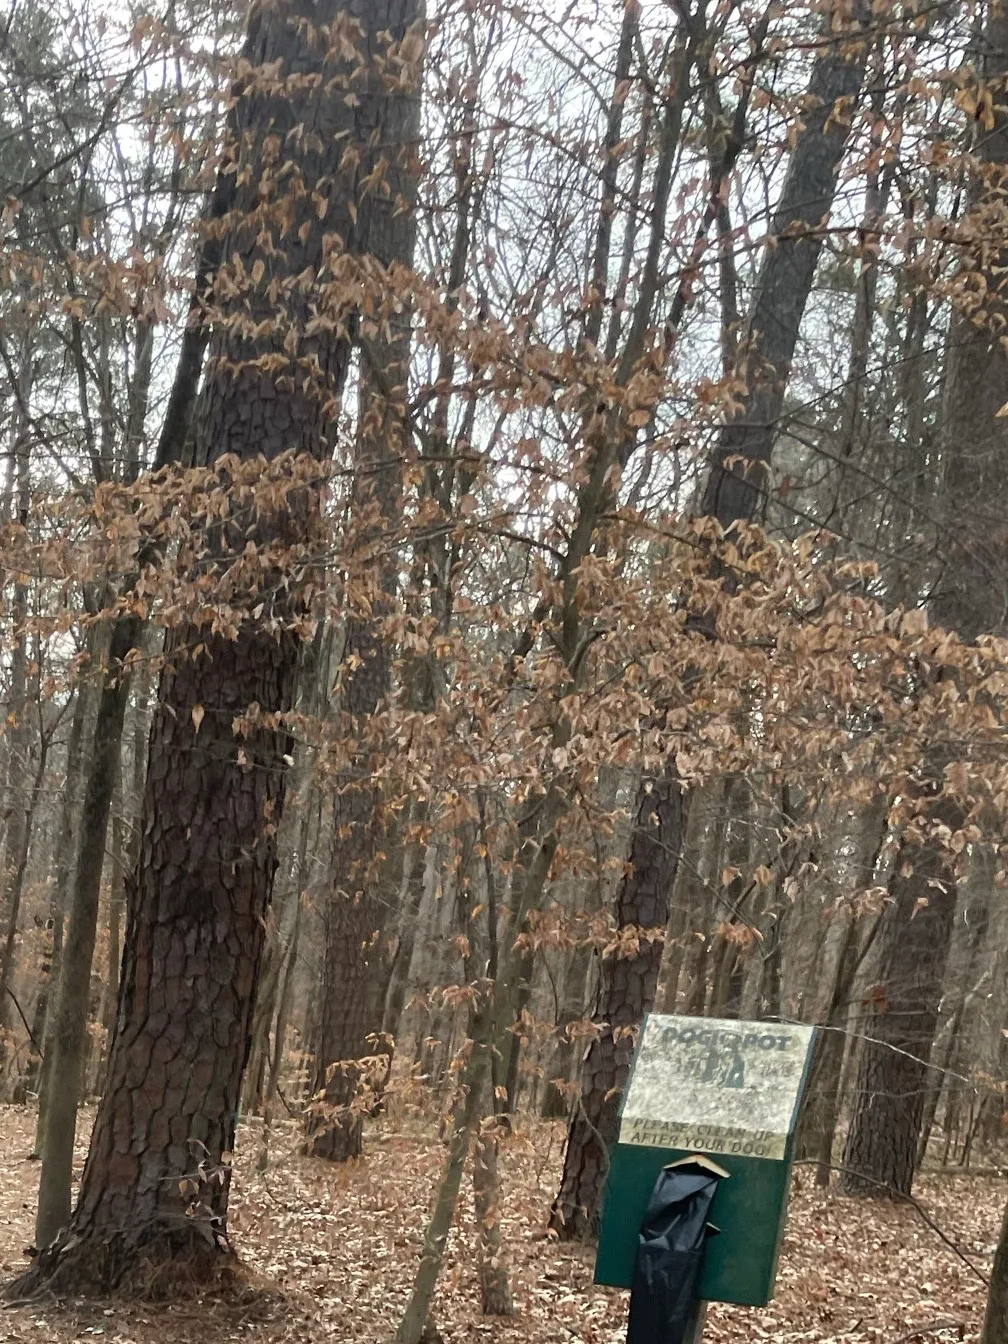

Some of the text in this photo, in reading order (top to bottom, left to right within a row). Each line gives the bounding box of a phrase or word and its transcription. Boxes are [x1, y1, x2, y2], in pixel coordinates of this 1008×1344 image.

[633, 1118, 774, 1141] PLEASE CLEAN UP
[631, 1132, 677, 1147] AFTER
[684, 1137, 725, 1152] YOUR
